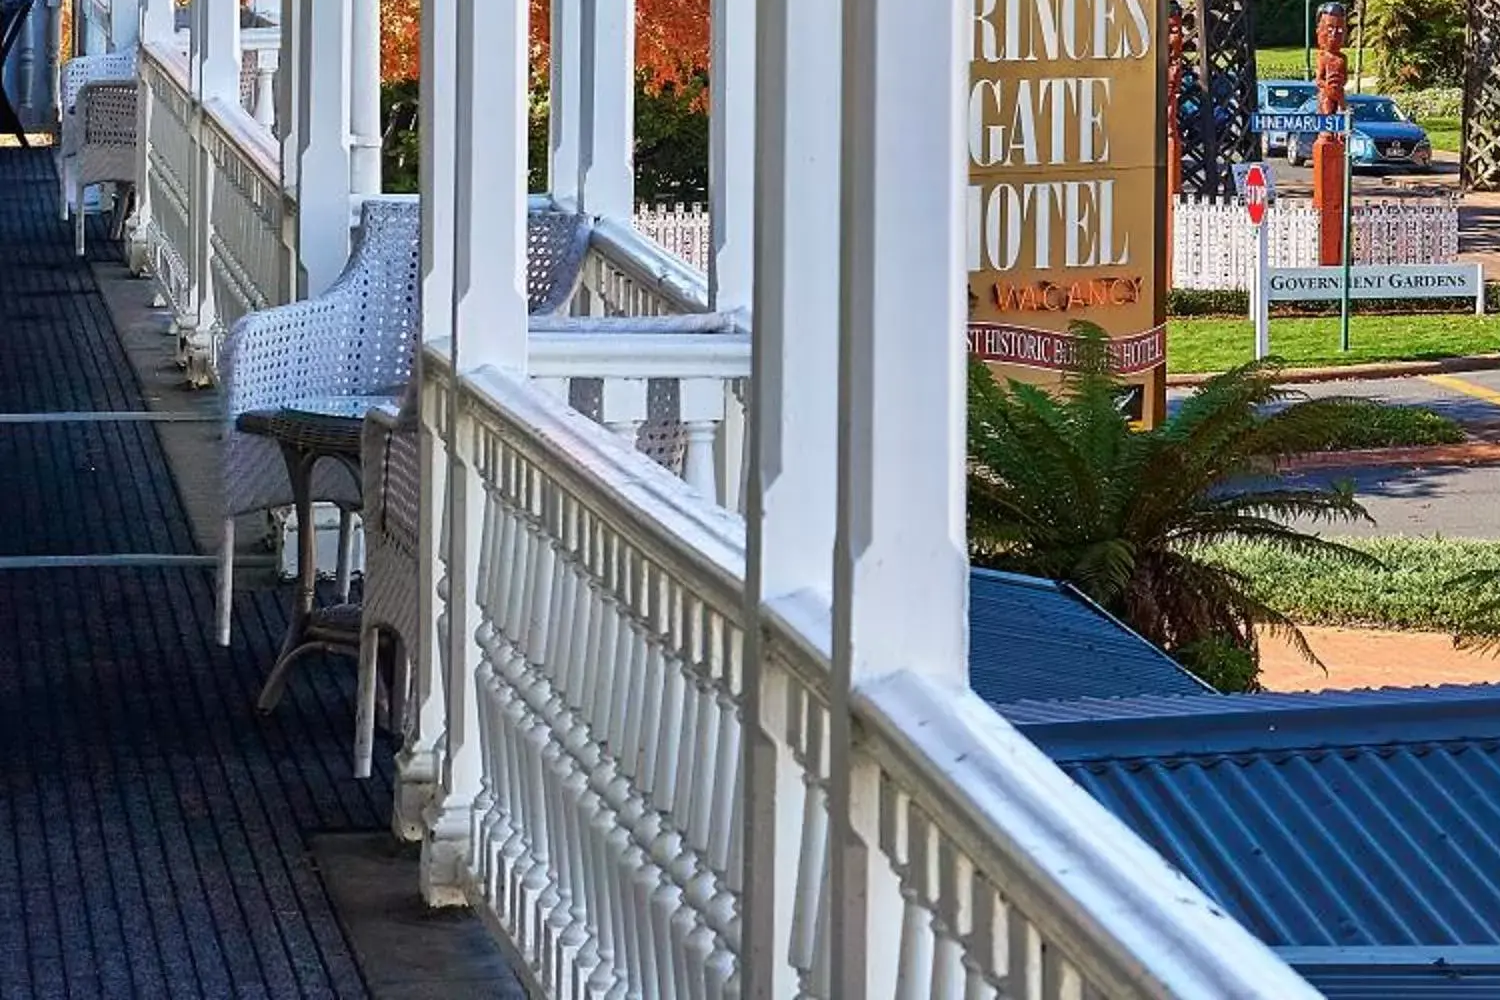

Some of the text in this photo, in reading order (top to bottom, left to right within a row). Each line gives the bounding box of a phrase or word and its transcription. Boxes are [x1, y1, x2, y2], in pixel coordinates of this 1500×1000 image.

[969, 76, 1111, 166] GATE
[1325, 115, 1341, 131] ST
[994, 277, 1144, 311] VACANCY
[1389, 273, 1466, 288] GARDENS
[985, 329, 1050, 363] HISTORIC
[1123, 334, 1163, 368] HOTEL
